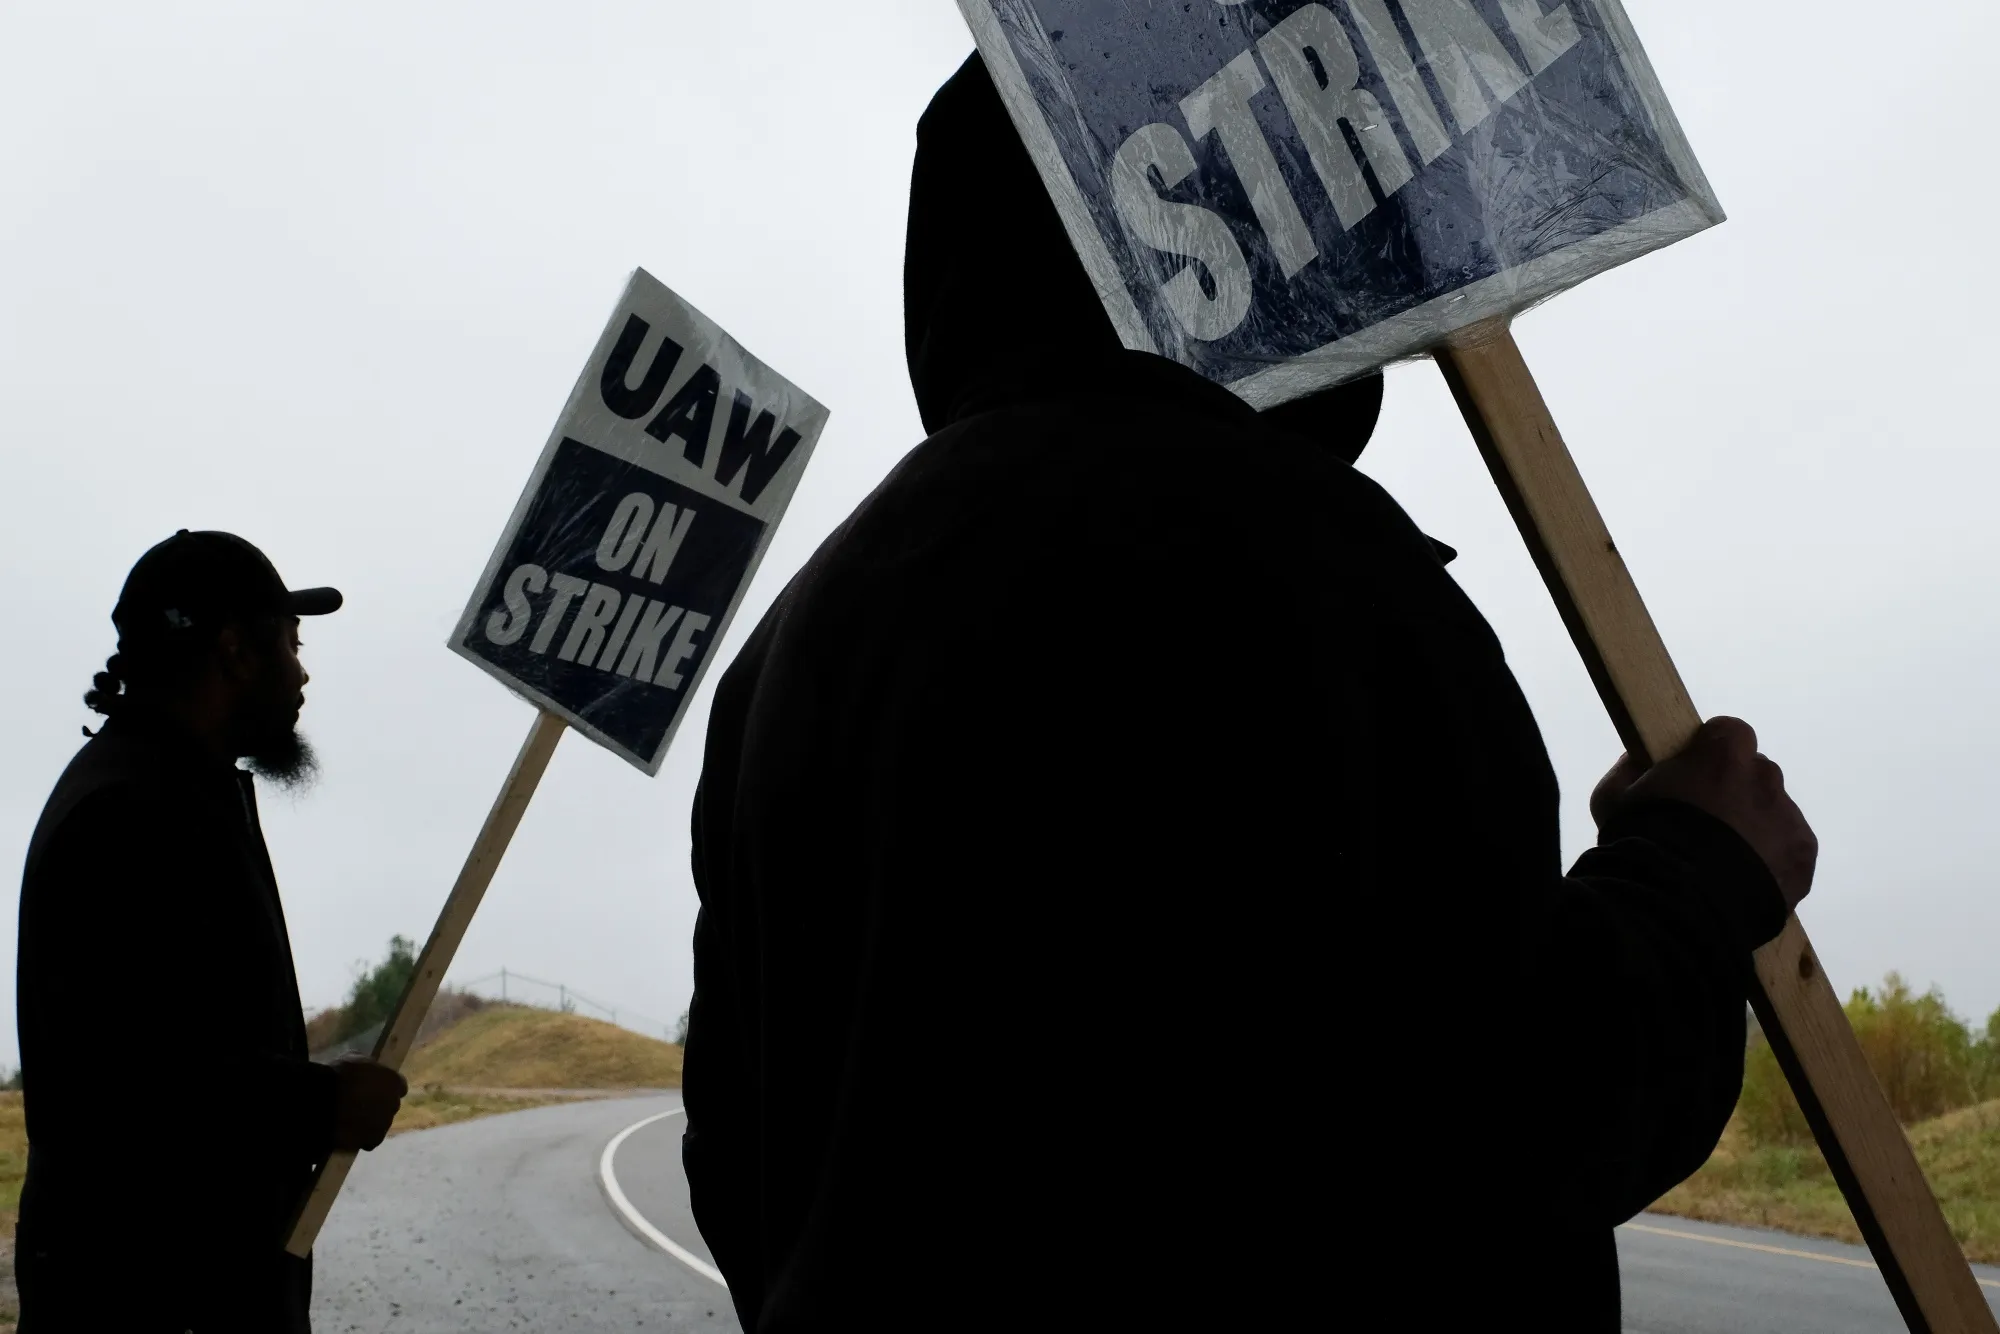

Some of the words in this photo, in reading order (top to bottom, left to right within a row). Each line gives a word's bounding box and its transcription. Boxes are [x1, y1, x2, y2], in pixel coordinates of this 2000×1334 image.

[600, 313, 802, 505] UAW
[597, 492, 696, 585] ON
[485, 563, 711, 690] STRIKE
